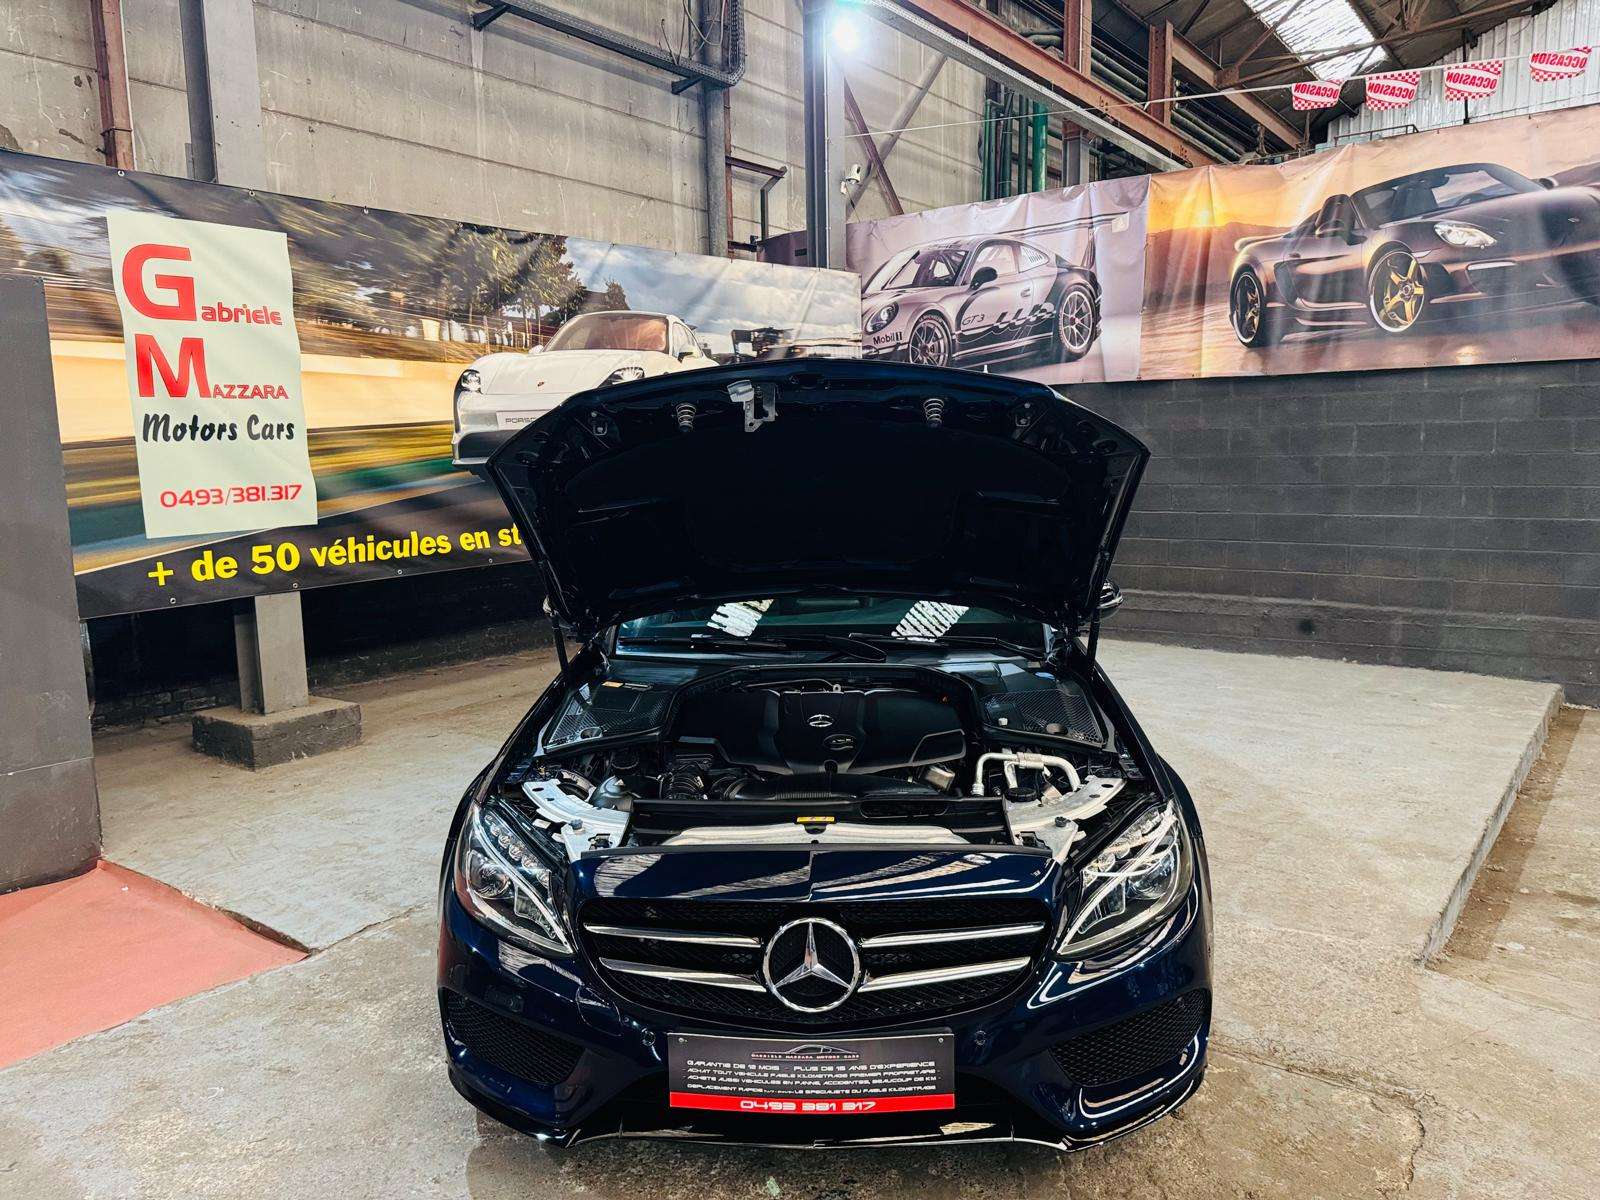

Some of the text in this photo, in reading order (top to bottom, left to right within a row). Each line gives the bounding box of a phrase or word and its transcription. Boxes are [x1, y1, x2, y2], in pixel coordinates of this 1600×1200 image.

[122, 243, 283, 326] Gabriele
[961, 313, 985, 326] GT3
[142, 413, 295, 443] Motors Cars
[159, 484, 303, 508] 0493/381.317
[147, 522, 522, 586] + de 50 véhicules en st
[740, 1100, 877, 1112] 0493 381 317
